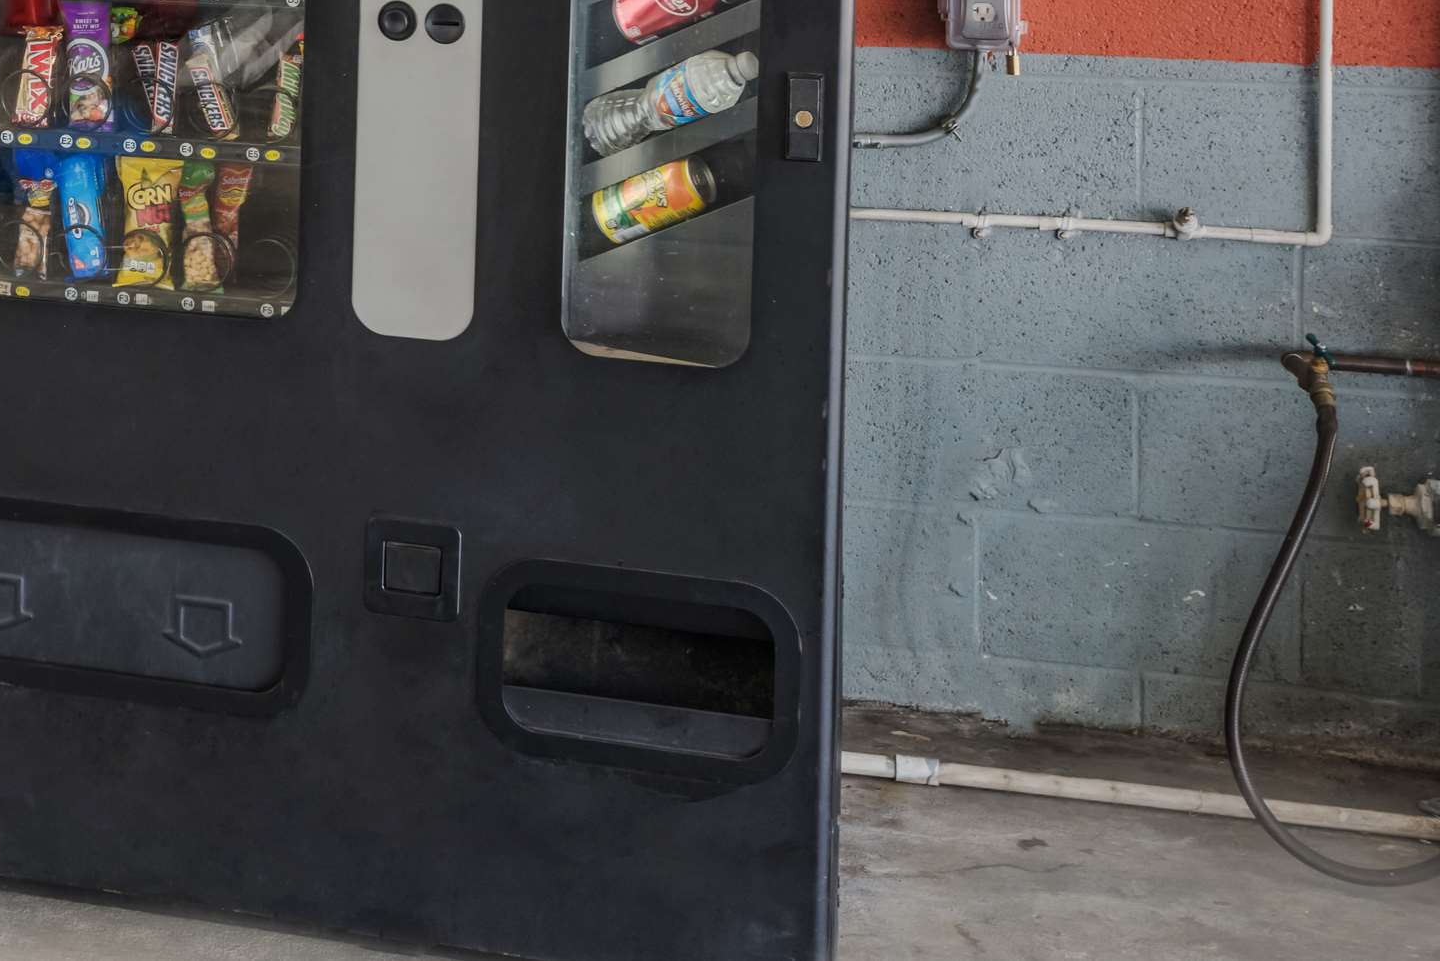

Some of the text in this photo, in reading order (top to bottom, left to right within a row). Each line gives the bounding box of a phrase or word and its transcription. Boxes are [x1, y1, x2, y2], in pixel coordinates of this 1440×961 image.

[2, 132, 12, 141] E1
[61, 136, 72, 145] E2
[125, 141, 135, 150] E3
[181, 144, 192, 154] E4
[247, 149, 259, 158] E5
[127, 182, 172, 211] CORN
[66, 290, 77, 299] F2
[118, 293, 129, 303] F3
[182, 299, 194, 308] F4
[262, 305, 273, 315] F5
